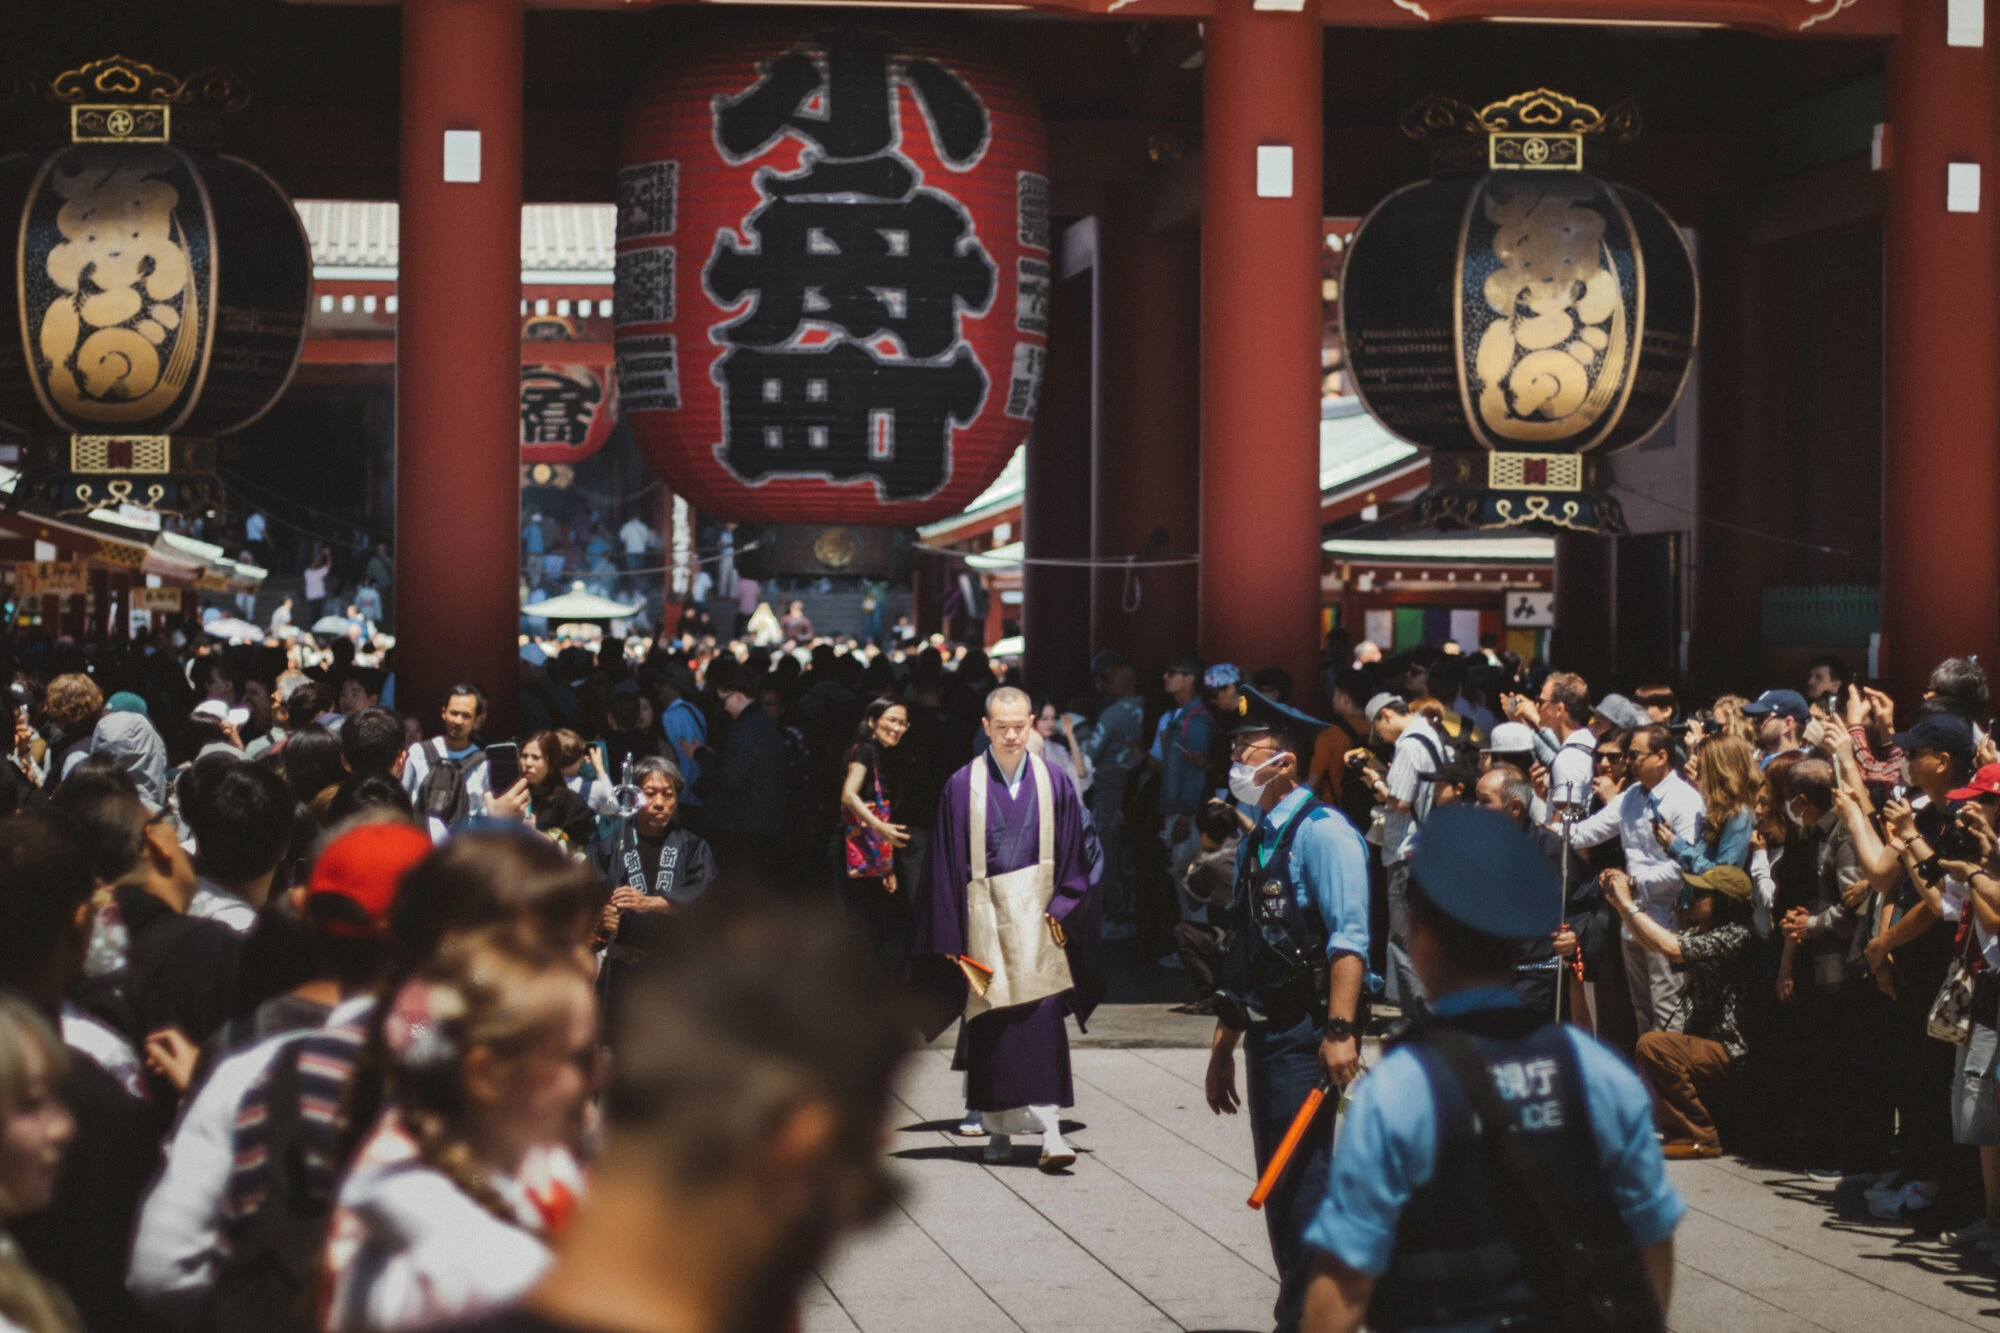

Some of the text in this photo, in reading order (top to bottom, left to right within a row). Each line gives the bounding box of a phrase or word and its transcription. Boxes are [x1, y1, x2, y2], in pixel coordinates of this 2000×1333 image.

[703, 38, 998, 503] 小舟町
[624, 849, 648, 894] 新門
[655, 845, 678, 892] 新門
[1488, 1059, 1557, 1099] 視庁
